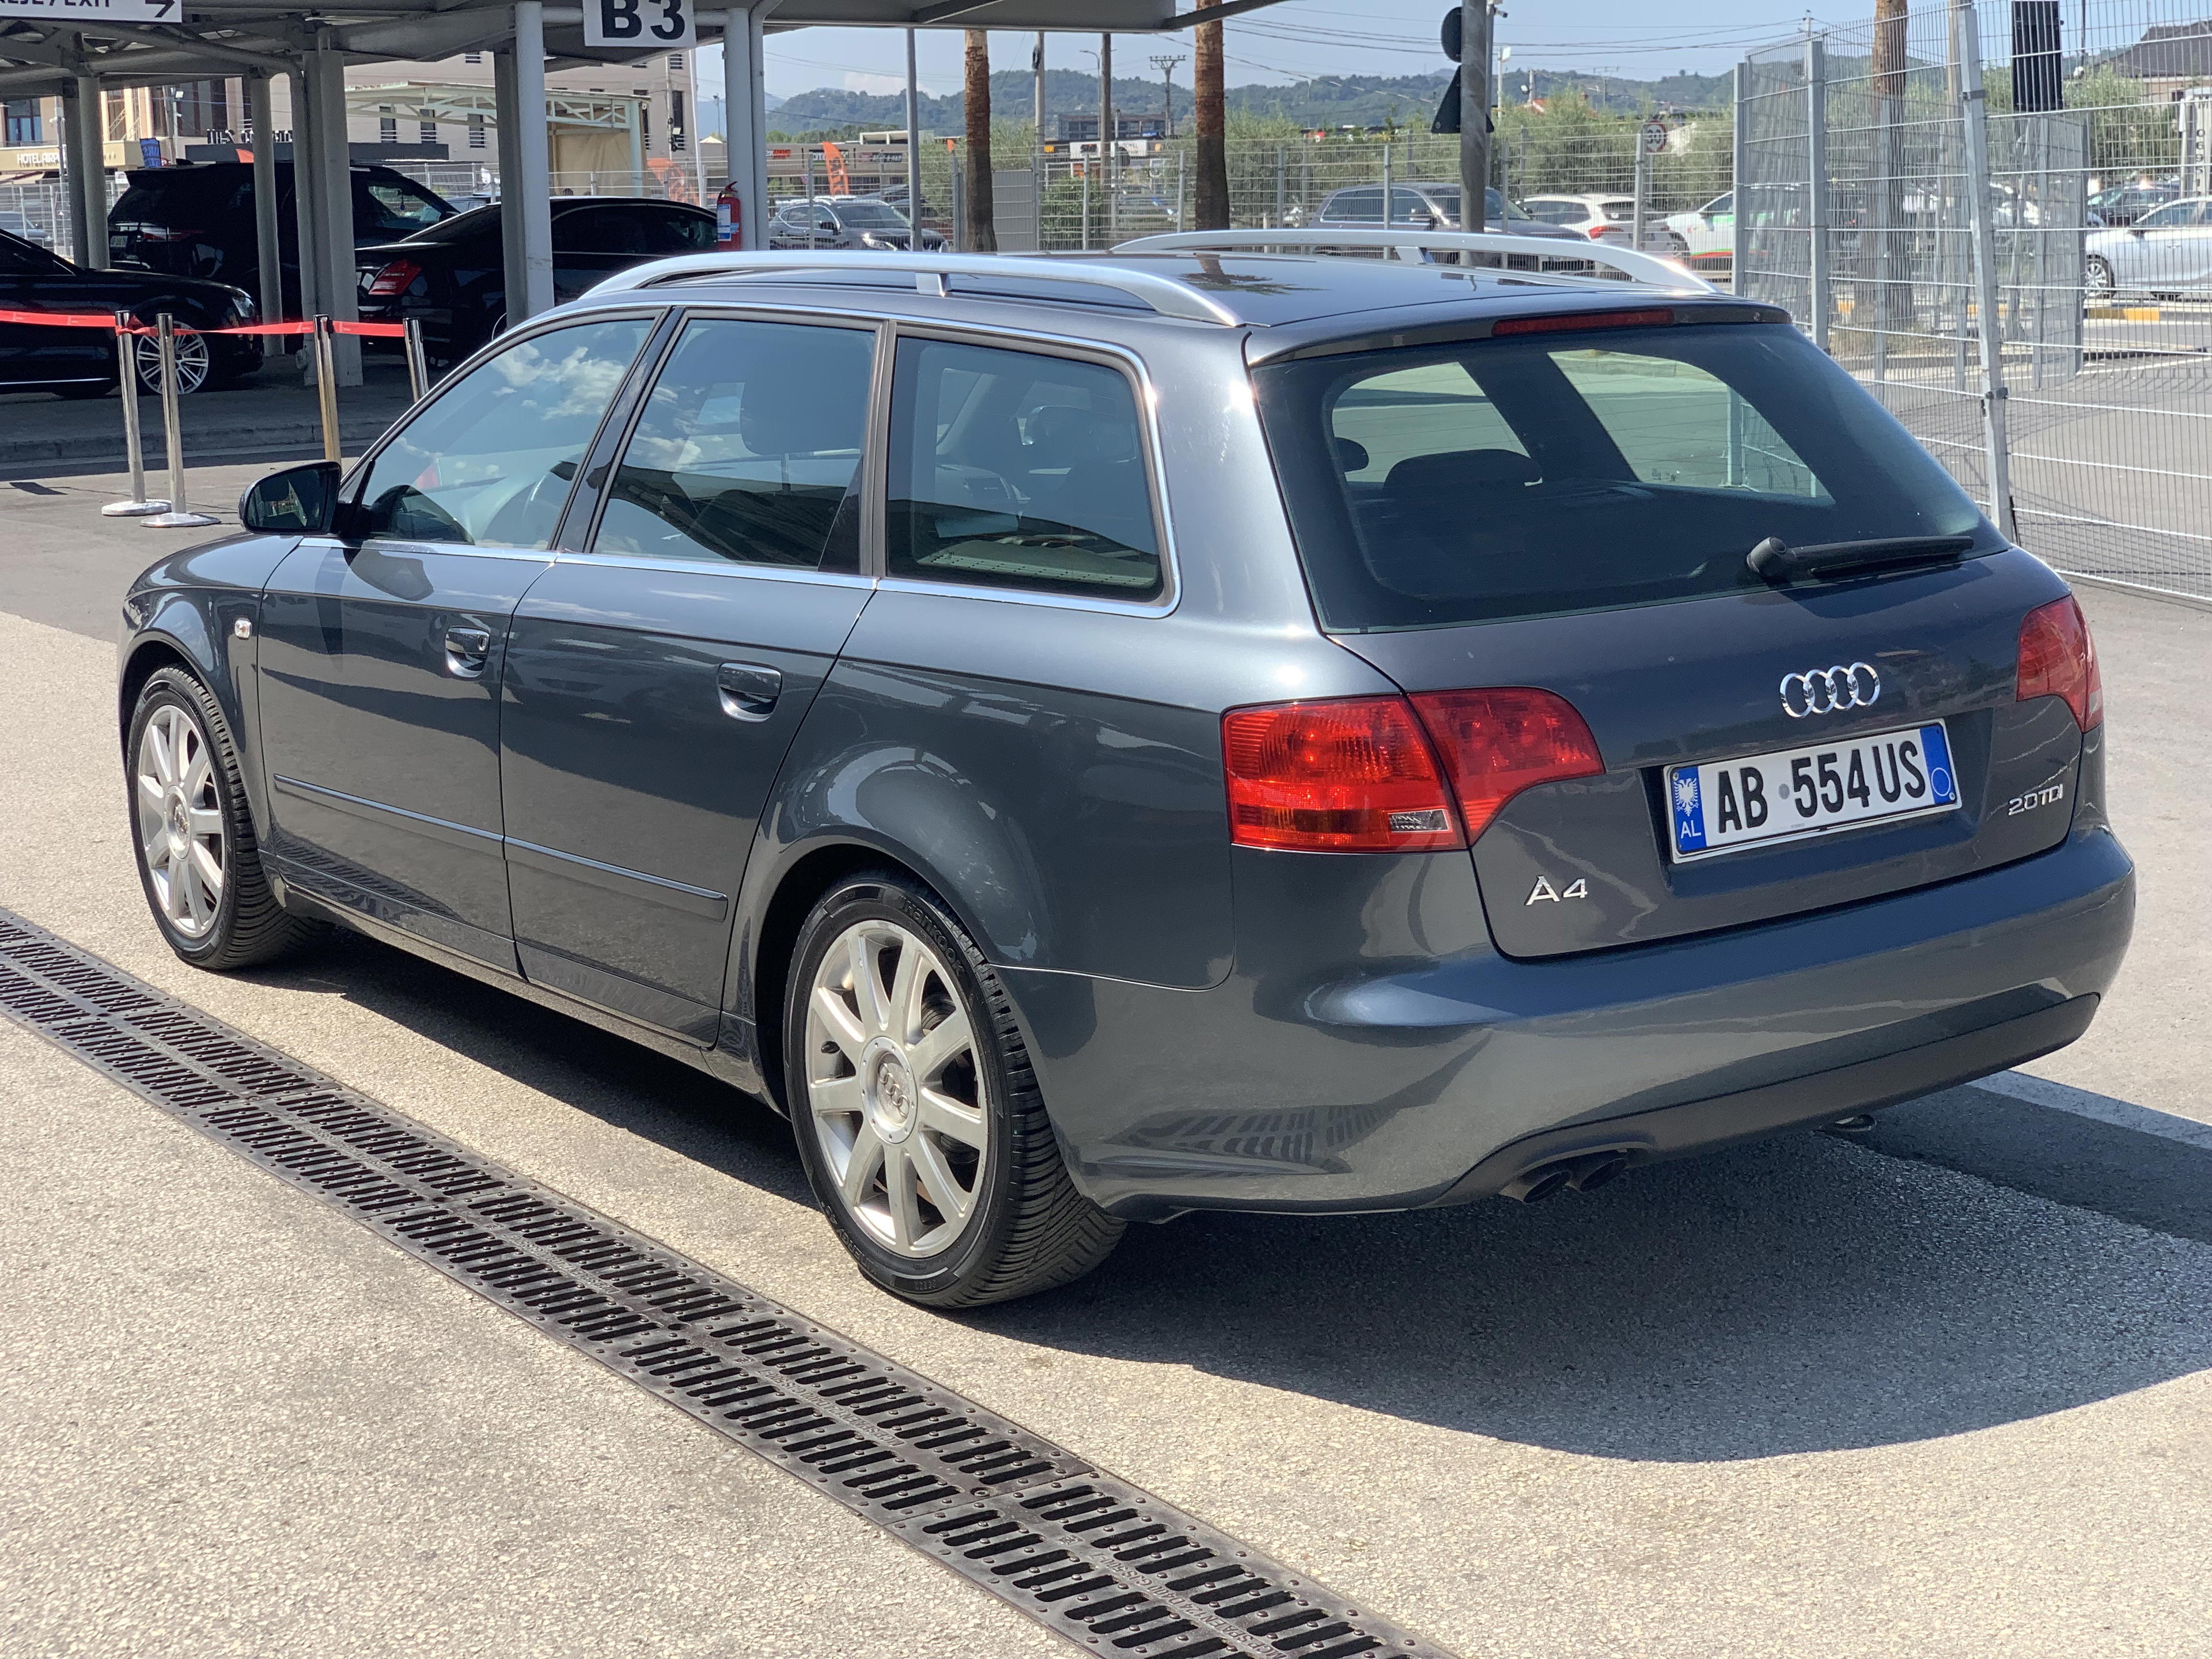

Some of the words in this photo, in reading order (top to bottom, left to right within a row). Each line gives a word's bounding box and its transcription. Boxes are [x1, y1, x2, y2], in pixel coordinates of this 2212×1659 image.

[17, 153, 42, 165] HOTEL
[1718, 766, 1768, 834] AB
[1680, 820, 1702, 839] AL
[1524, 875, 1588, 906] A4
